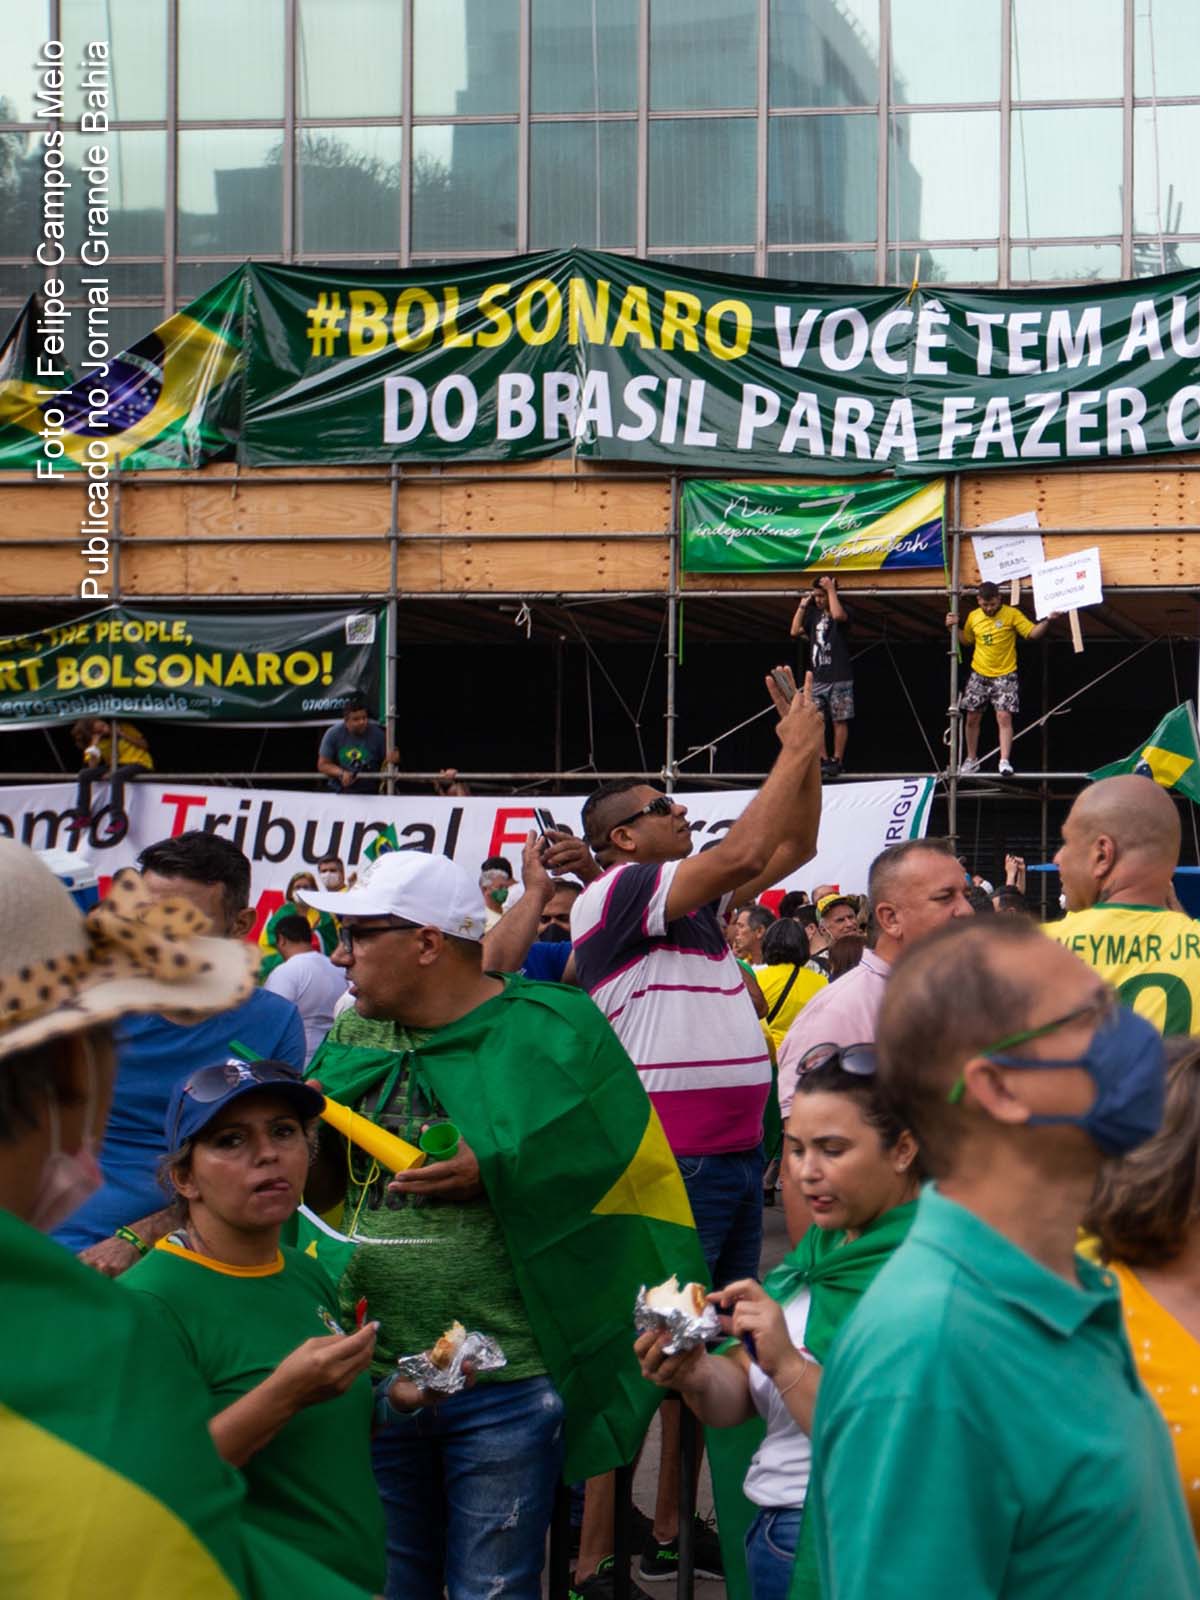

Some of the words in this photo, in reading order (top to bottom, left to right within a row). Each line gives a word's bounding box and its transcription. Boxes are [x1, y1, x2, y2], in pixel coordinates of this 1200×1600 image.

[306, 278, 754, 361] #BOLSONARO
[773, 299, 950, 376] VOCÊ
[966, 306, 1104, 376] TEM
[382, 375, 478, 445] DO
[496, 371, 718, 448] BRASIL
[737, 383, 920, 462] PARA
[937, 386, 1149, 460] FAZER
[723, 495, 784, 519] New
[695, 520, 802, 546] independence
[95, 619, 193, 647] PEOPLE,
[56, 651, 333, 689] BOLSONARO!
